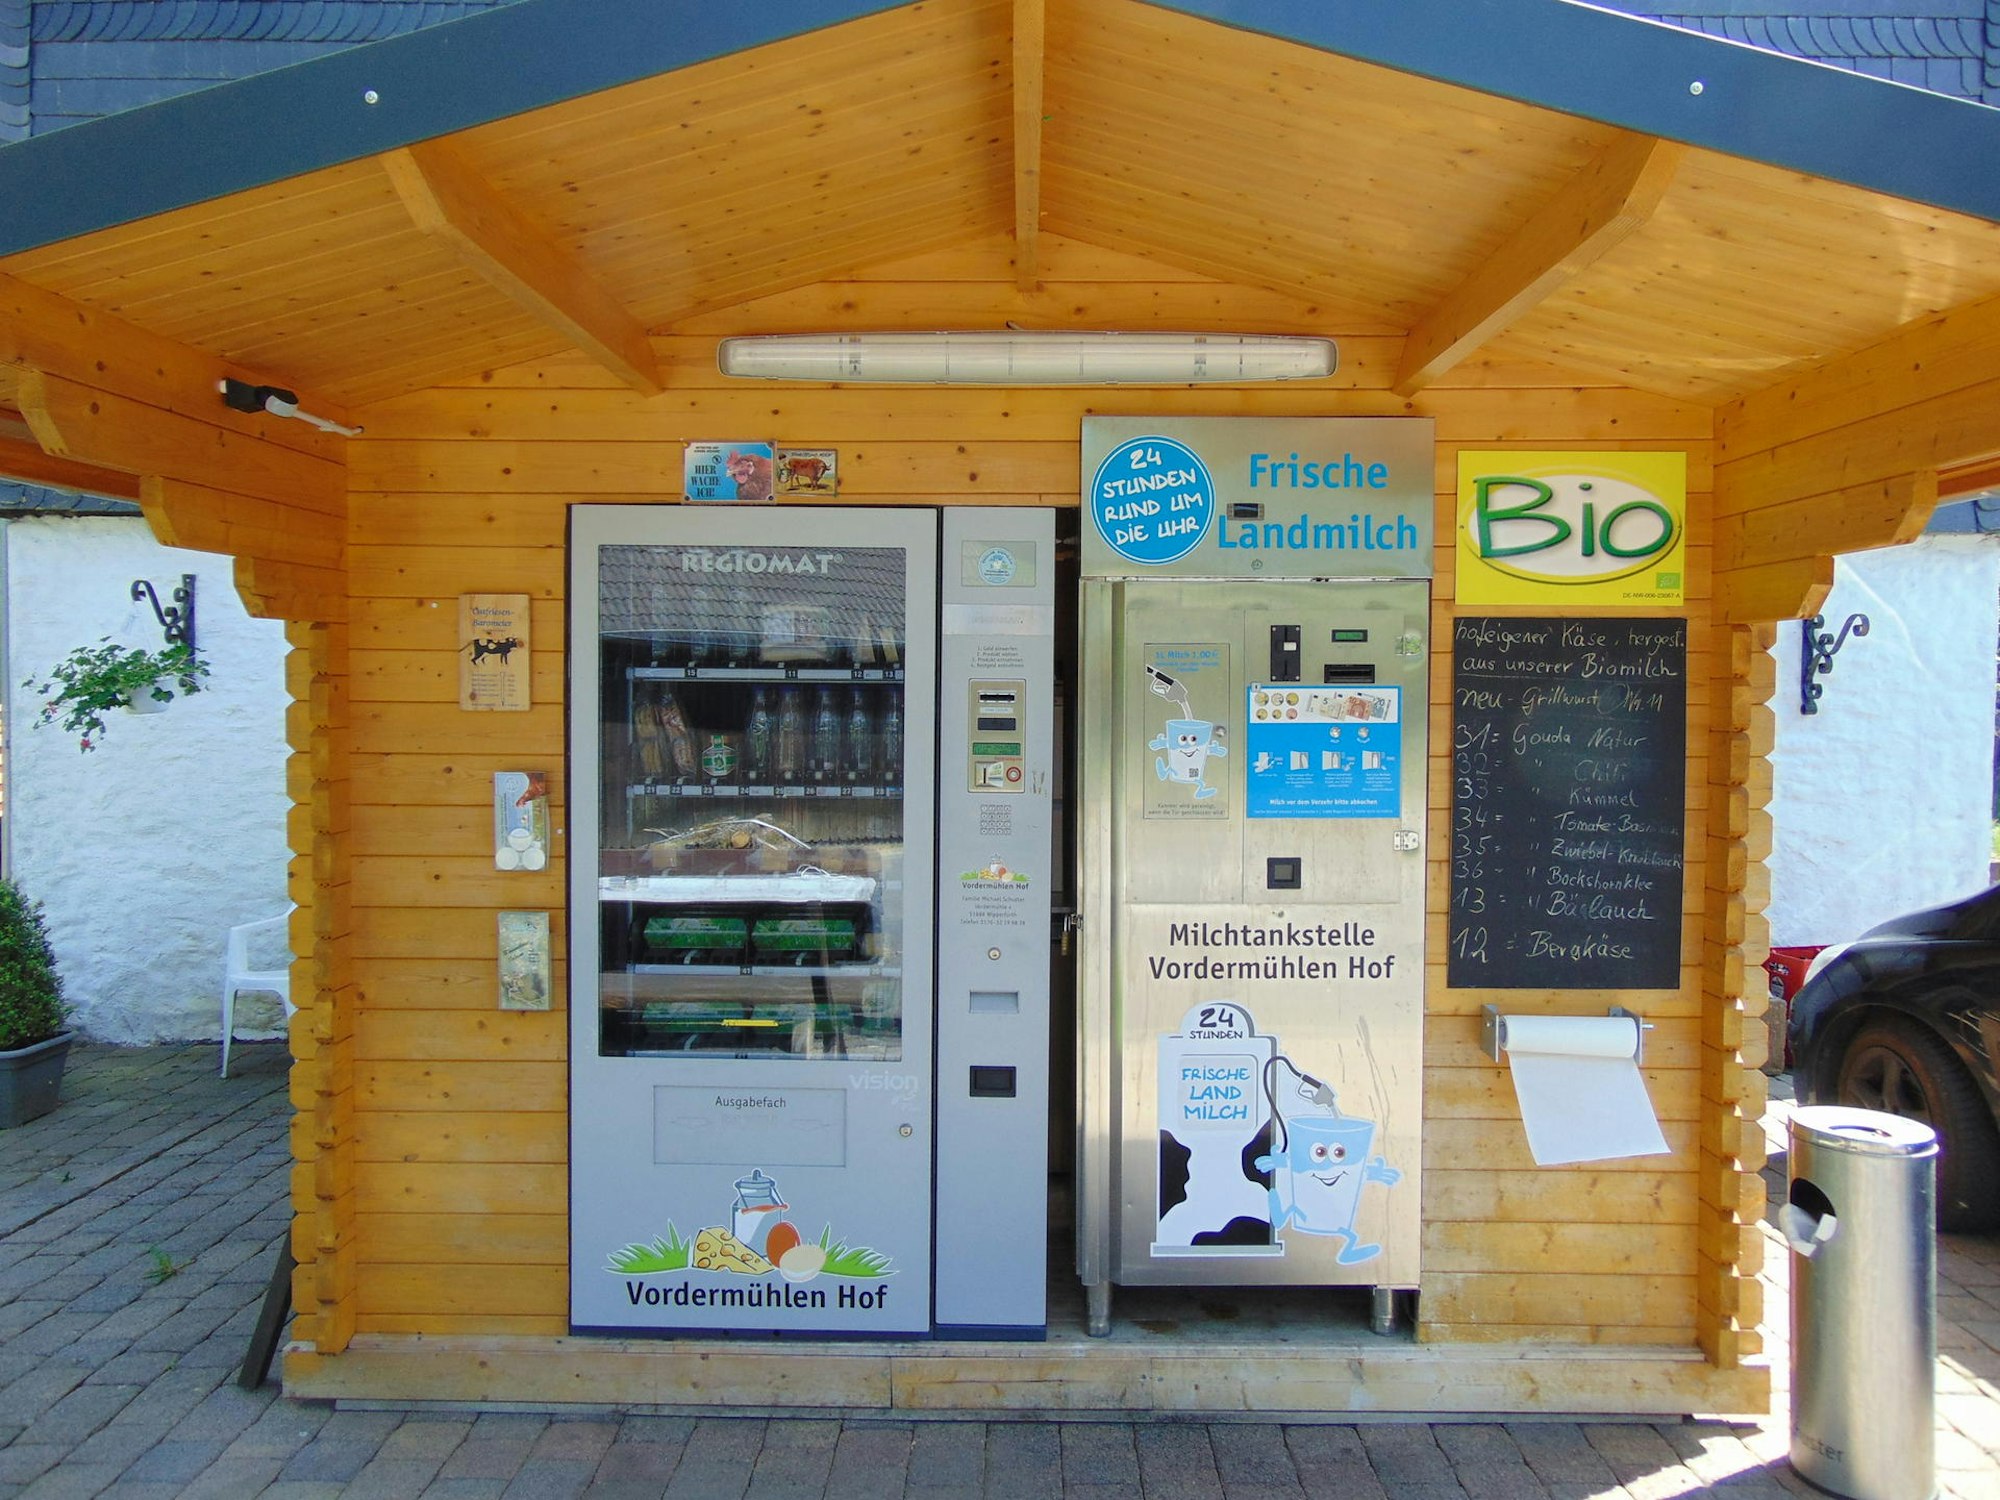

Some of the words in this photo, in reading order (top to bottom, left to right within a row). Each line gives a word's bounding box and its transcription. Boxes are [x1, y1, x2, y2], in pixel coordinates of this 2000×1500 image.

[694, 465, 717, 474] HIER
[1130, 447, 1162, 470] 24
[1249, 452, 1388, 489] Frische
[691, 476, 721, 486] WACHE
[1103, 467, 1197, 499] STUNDEN
[1104, 499, 1161, 523] RUND
[1170, 492, 1204, 512] UM
[1473, 475, 1673, 558] Bio
[1157, 516, 1200, 538] UHR
[1218, 513, 1417, 550] Landmilch
[1455, 618, 1548, 653] hofeigener
[1462, 656, 1496, 671] aus
[1505, 660, 1573, 673] unserer
[1580, 653, 1678, 678] Biomilch
[1456, 688, 1503, 710] neu
[1522, 686, 1600, 716] Grillwurst
[1512, 723, 1571, 756] Gouda
[1587, 727, 1647, 748] Natur
[1569, 786, 1639, 808] Kümmel
[1455, 887, 1486, 914] 13
[1169, 922, 1375, 947] Milchtankstelle
[1452, 926, 1489, 963] 12
[1525, 930, 1634, 961] Bergkäse
[1149, 955, 1337, 980] Vordermühlen
[1349, 954, 1396, 979] Hof
[1199, 1007, 1234, 1028] 24
[1189, 1030, 1243, 1039] STUNDEN
[848, 1069, 919, 1090] vision
[715, 1095, 787, 1109] Ausgabefach
[1189, 1086, 1242, 1100] LAND
[626, 1280, 826, 1308] Vordermühlen
[838, 1284, 888, 1309] Hof
